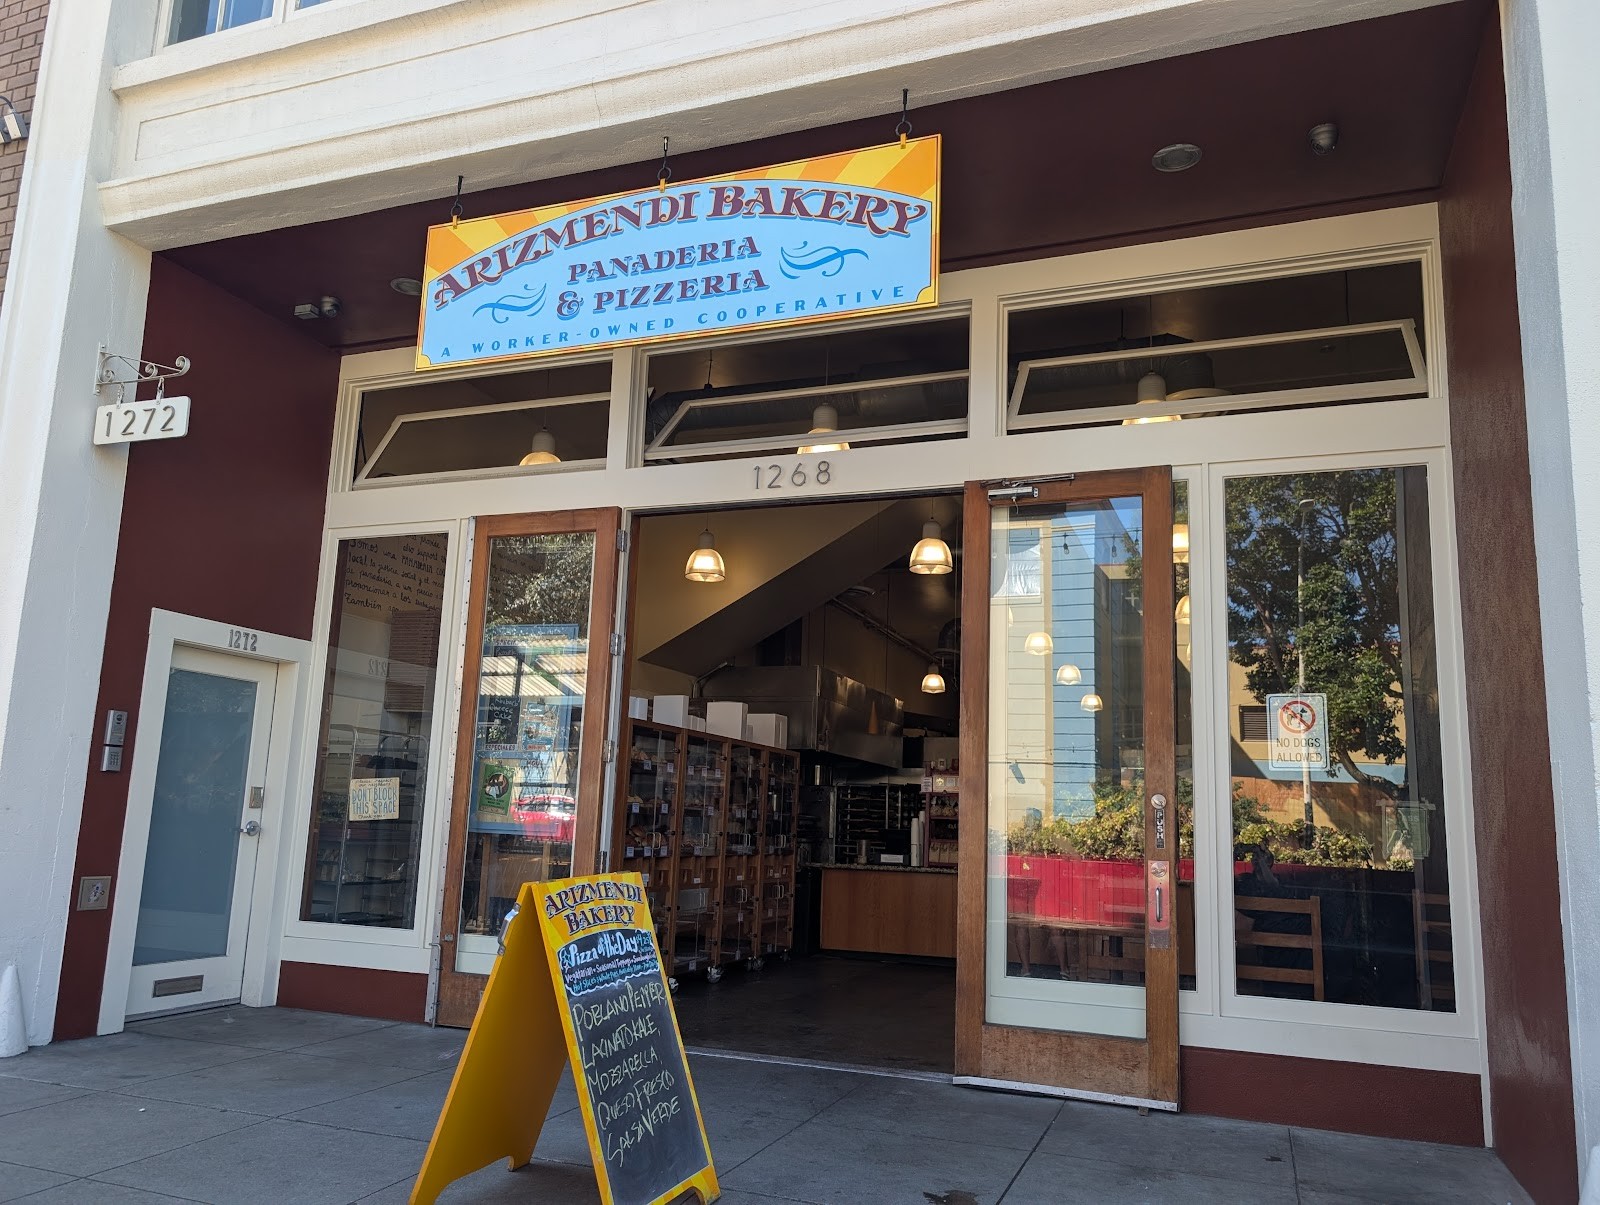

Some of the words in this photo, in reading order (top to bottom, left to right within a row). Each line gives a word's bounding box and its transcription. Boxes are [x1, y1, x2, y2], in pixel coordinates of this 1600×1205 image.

[433, 192, 699, 311] ARIZMENDI
[706, 185, 927, 238] BAKERY
[568, 236, 762, 286] PANADERIA
[556, 290, 582, 319] &
[593, 269, 771, 314] PIZZERIA
[440, 347, 451, 358] A
[472, 317, 675, 354] WORKER-OWNED
[697, 285, 905, 325] COOPERATIVE
[106, 405, 176, 437] 1272
[754, 460, 831, 489] 1268
[228, 629, 258, 651] 1272
[1276, 738, 1290, 748] NO
[1293, 737, 1321, 748] DOGS
[1276, 752, 1323, 763] ALLOWED
[352, 801, 369, 814] THIS
[372, 800, 396, 814] SPACE
[373, 786, 397, 802] BLOCK
[1156, 811, 1164, 839] PUSH
[545, 881, 644, 919] ARIZMENDI
[564, 905, 635, 935] BAKERY
[568, 943, 599, 967] Pizza
[616, 931, 638, 955] Day
[572, 994, 629, 1042] POBLANO
[582, 1023, 634, 1070] LACINATO
[598, 1092, 636, 1130] QUESO
[633, 1069, 675, 1110] FRESCO
[642, 1096, 681, 1137] VERDE
